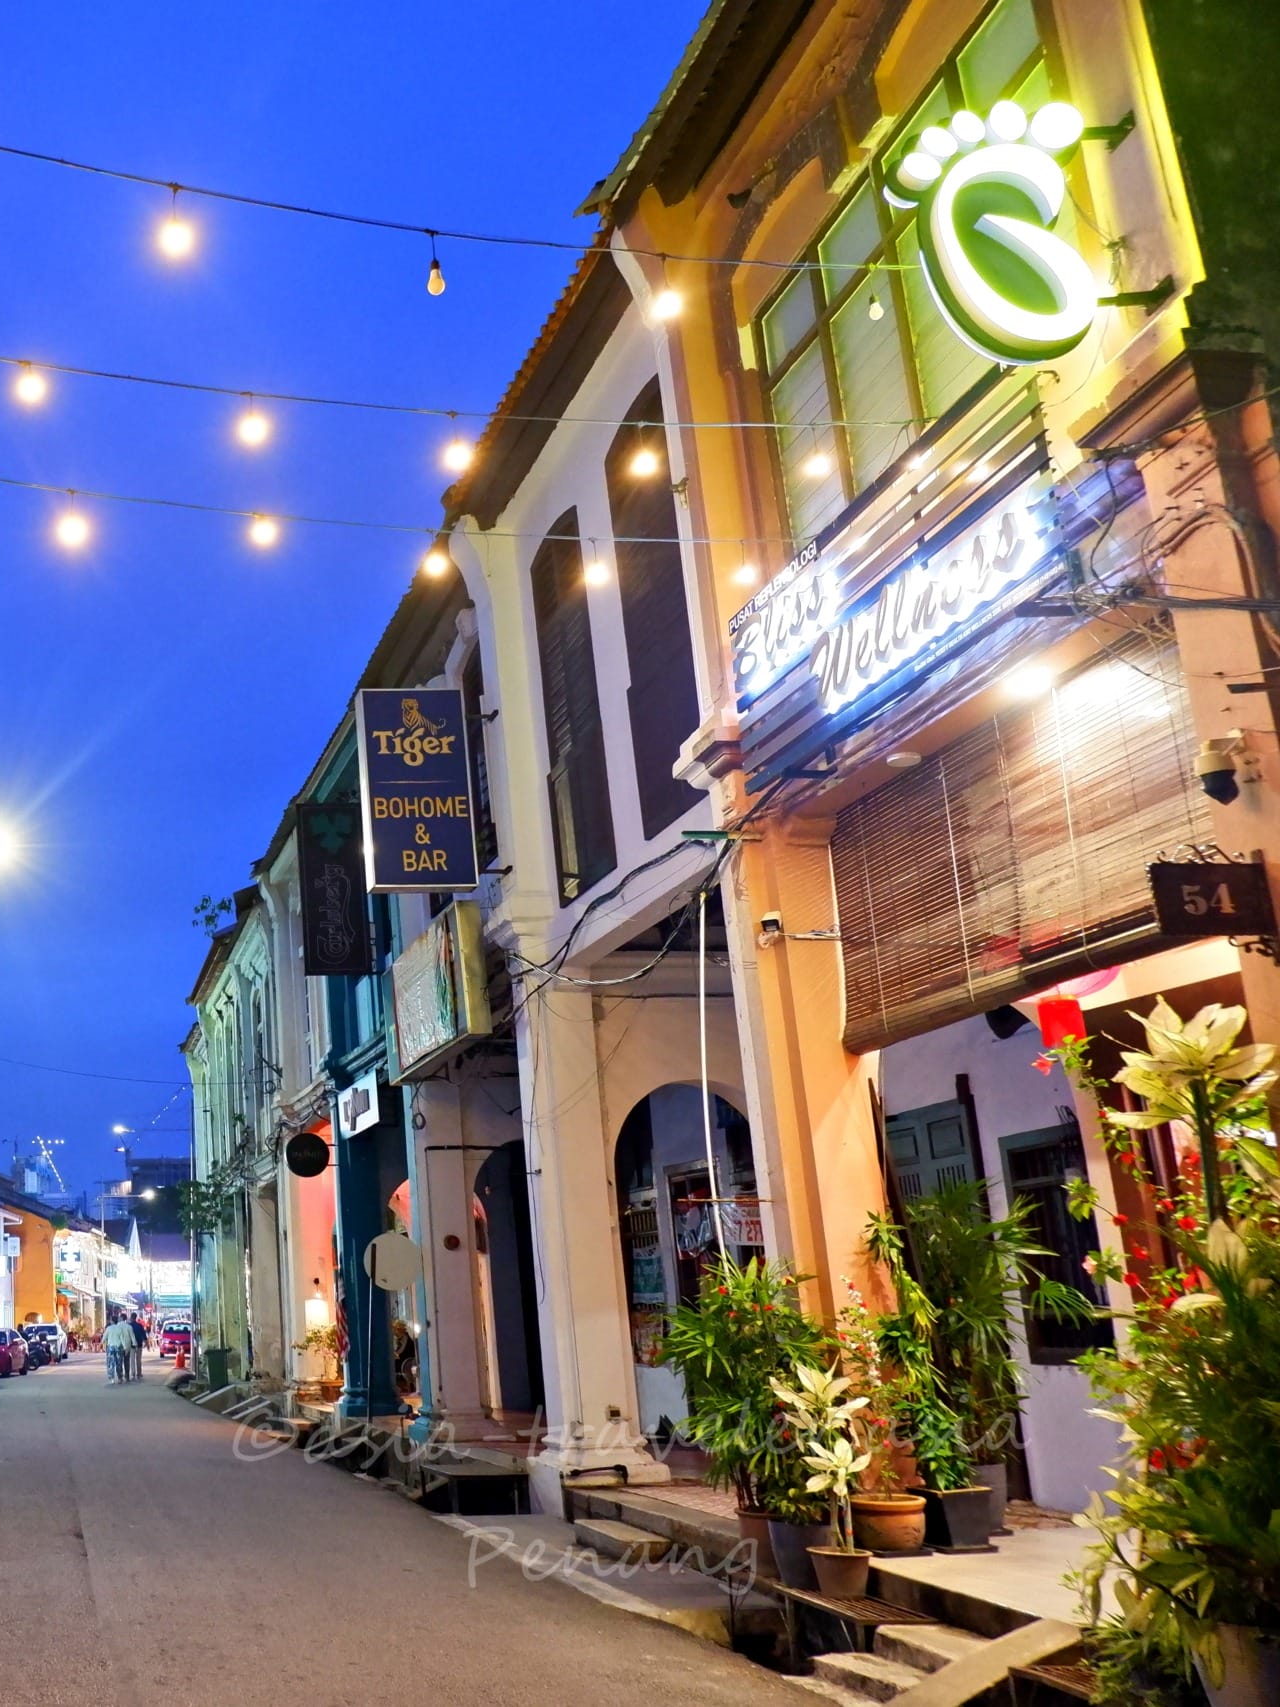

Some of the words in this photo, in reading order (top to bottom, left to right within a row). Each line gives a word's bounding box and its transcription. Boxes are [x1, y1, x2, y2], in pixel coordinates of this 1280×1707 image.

[729, 600, 754, 633] PUSAT
[809, 510, 1026, 704] Wellness
[734, 572, 826, 679] Bliss
[372, 727, 455, 767] Tiger
[373, 796, 469, 819] BOHOME
[414, 824, 431, 845] &
[402, 850, 448, 872] BAR
[1181, 883, 1238, 916] 54
